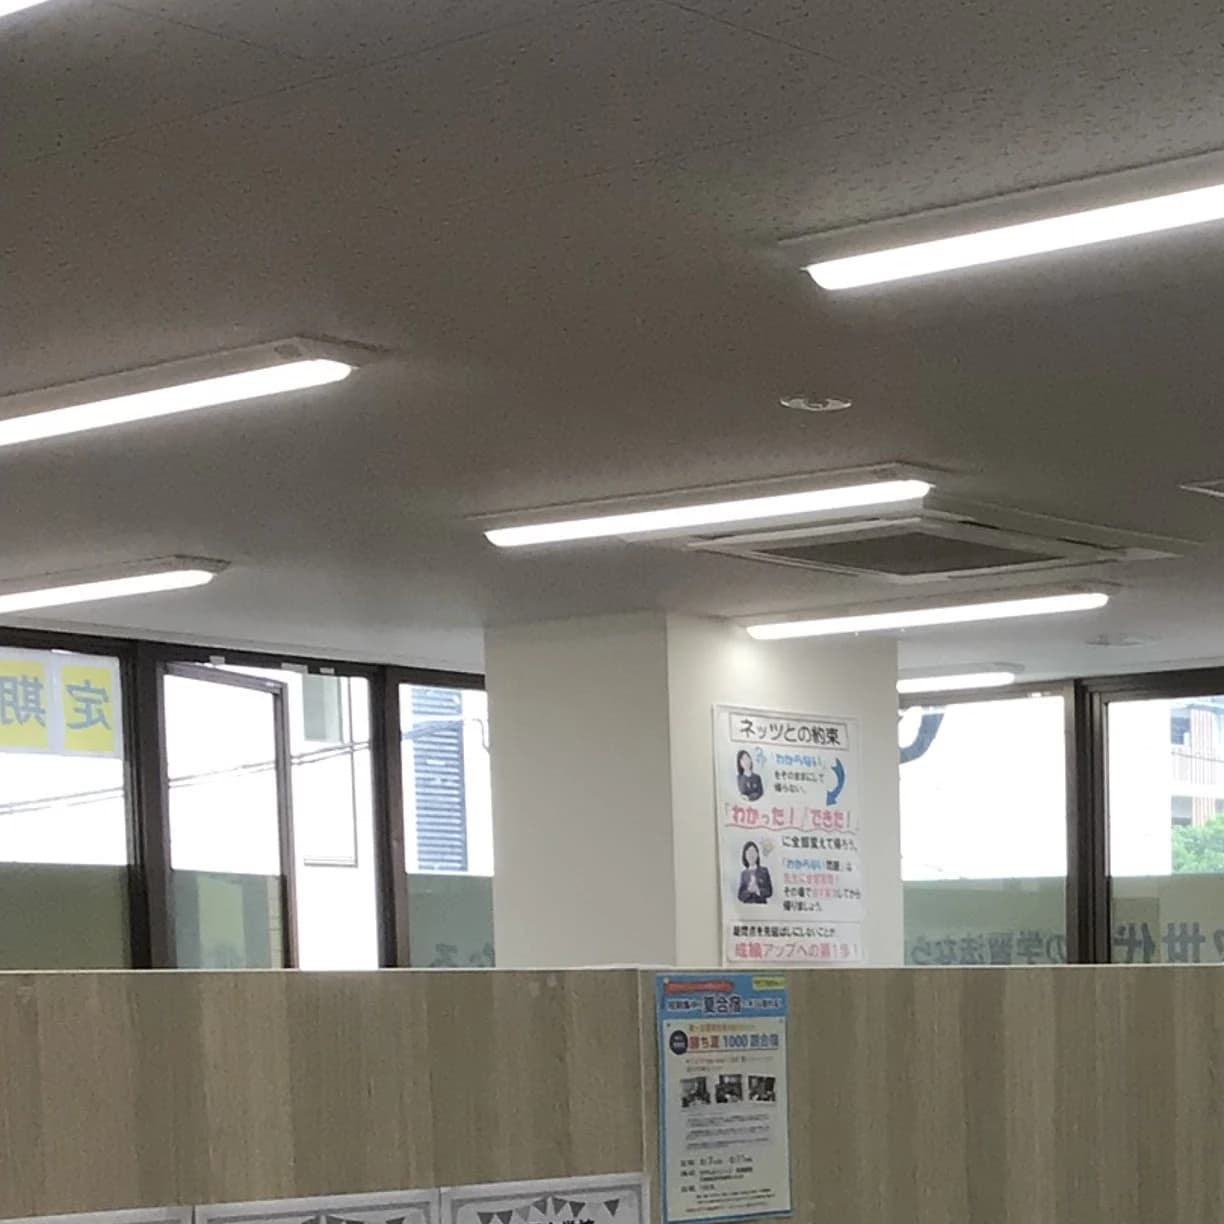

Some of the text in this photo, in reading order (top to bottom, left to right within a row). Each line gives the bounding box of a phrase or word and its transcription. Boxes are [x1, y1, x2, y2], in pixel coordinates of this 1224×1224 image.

[739, 719, 841, 746] ネッツとの約束
